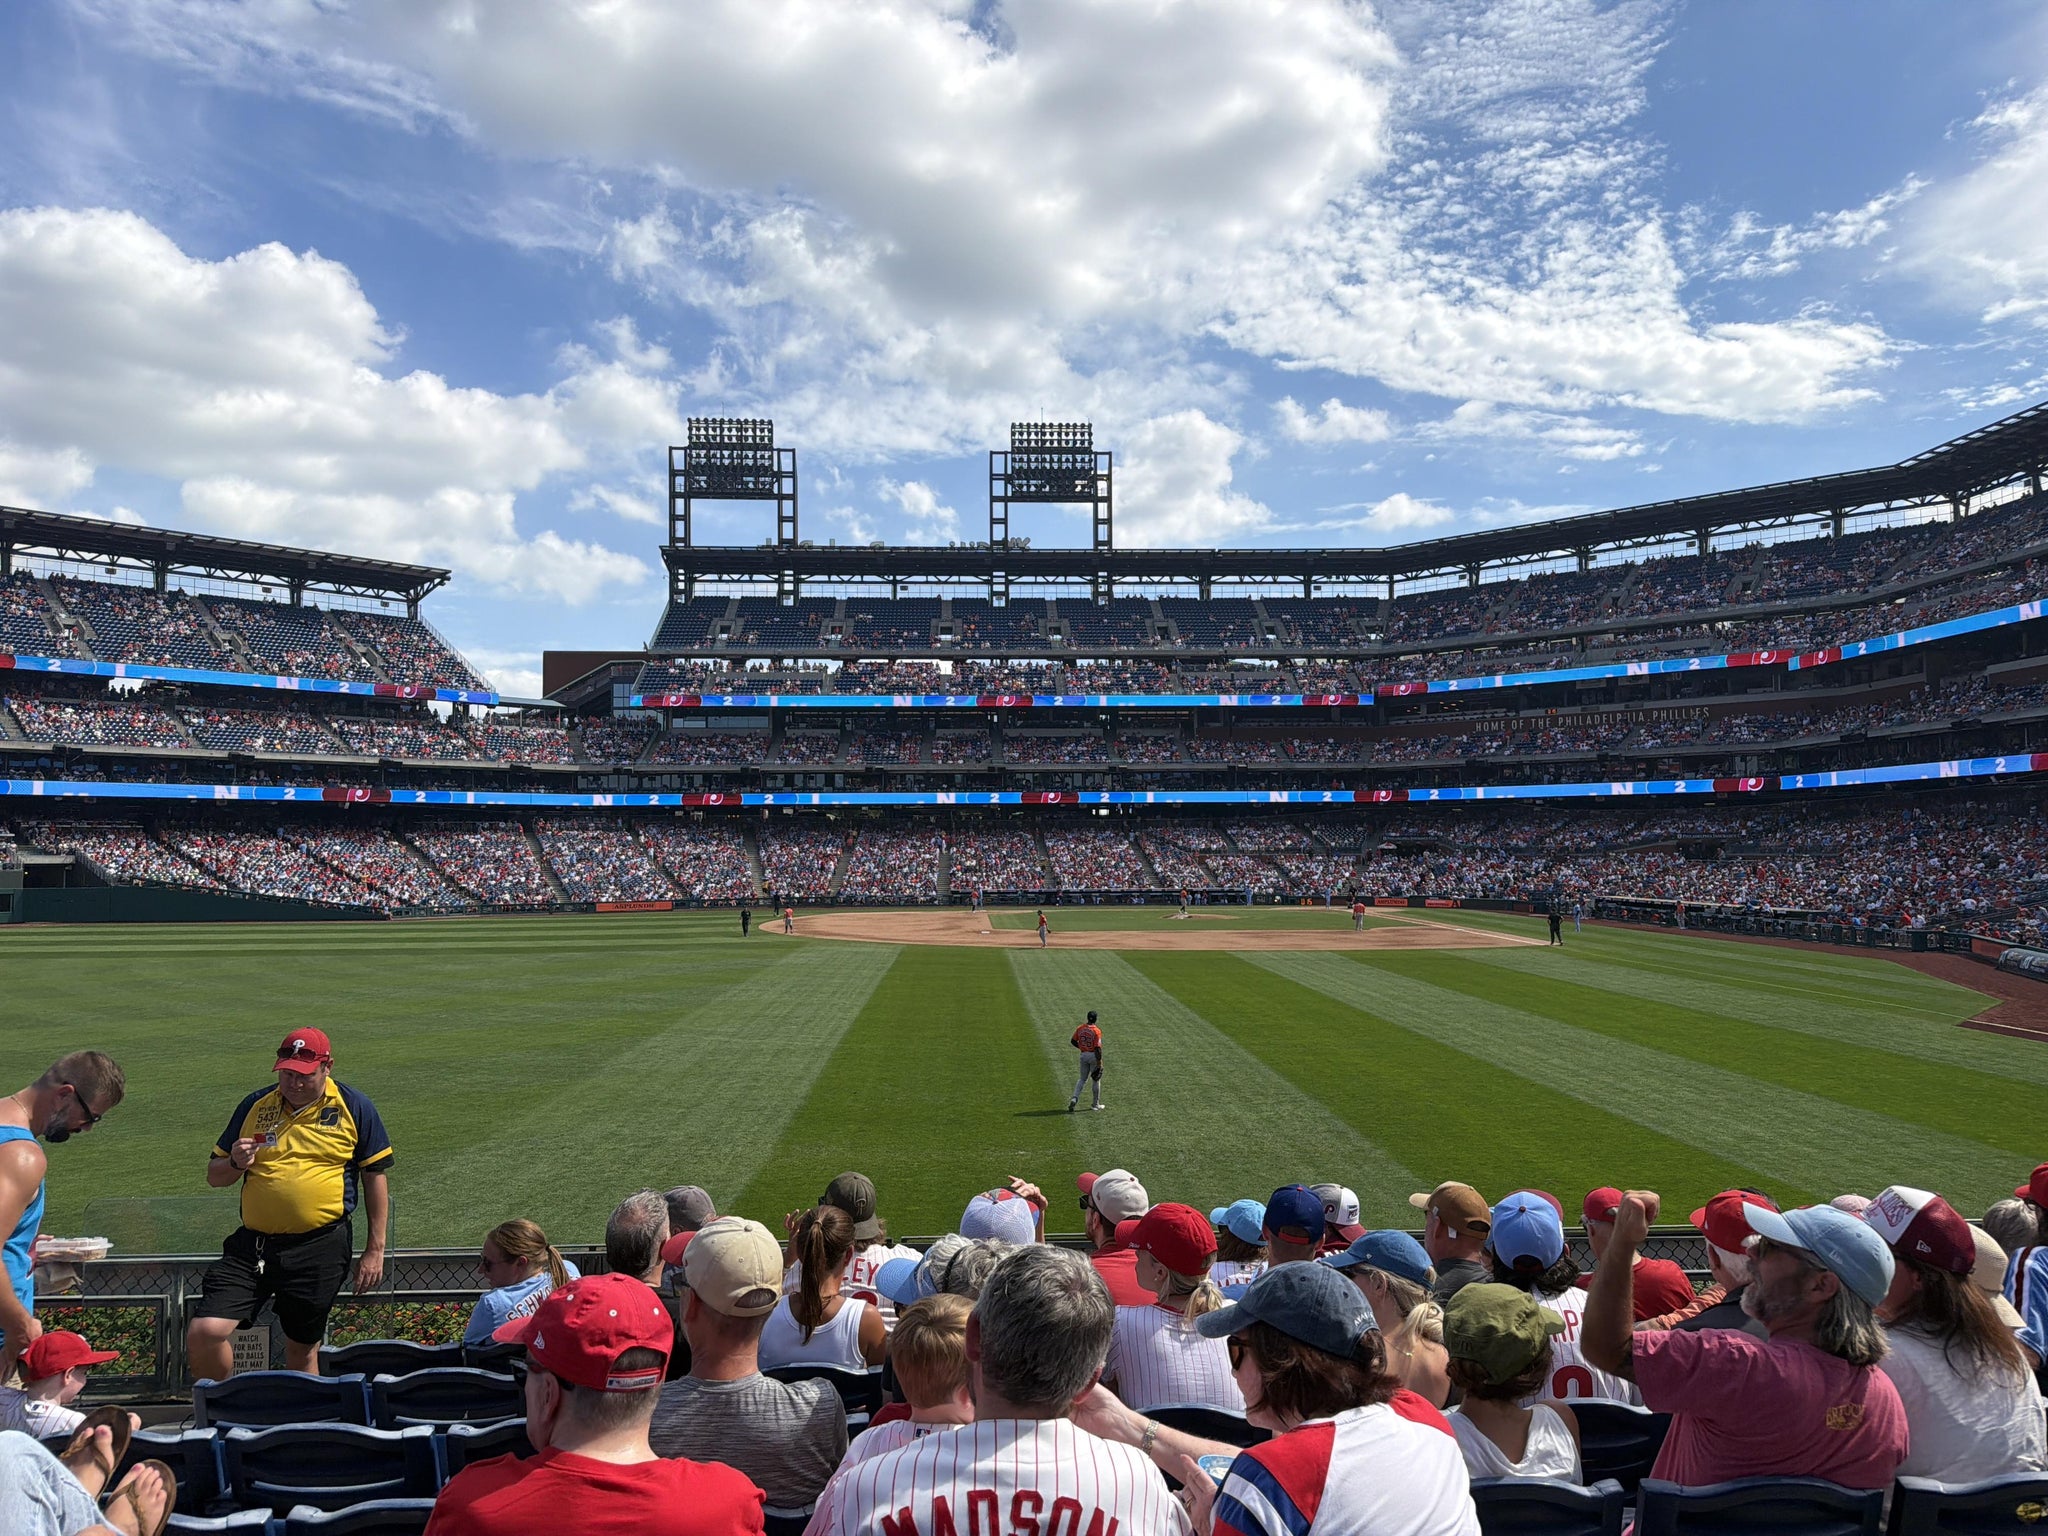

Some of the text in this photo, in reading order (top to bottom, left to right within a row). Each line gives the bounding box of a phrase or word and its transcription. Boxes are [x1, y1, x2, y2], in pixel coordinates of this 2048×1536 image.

[1858, 642, 1867, 655] 2
[2019, 602, 2041, 619] N
[48, 659, 61, 672] 2
[276, 676, 299, 689] N
[338, 682, 350, 693] 2
[458, 692, 468, 702] 2
[1448, 681, 1458, 691] 2
[1626, 662, 1649, 675] N
[1689, 658, 1700, 670] 2
[723, 696, 734, 706] 2
[894, 695, 912, 707] N
[946, 696, 956, 706] 2
[1054, 696, 1064, 706] 2
[1219, 695, 1238, 706] N
[1272, 696, 1282, 706] 2
[1475, 720, 1505, 732] HOME
[1511, 719, 1525, 731] OF
[1531, 717, 1551, 729] THE
[1652, 706, 1710, 722] PHILLIES
[214, 785, 239, 799] N
[283, 787, 296, 800] 2
[415, 791, 427, 803] 2
[592, 795, 613, 806] N
[649, 794, 660, 805] 2
[764, 794, 774, 804] 2
[936, 793, 956, 804] N
[990, 793, 1000, 804] 2
[1100, 793, 1111, 803] 2
[1269, 791, 1289, 803] N
[1322, 792, 1333, 803] 2
[1430, 789, 1440, 800] 2
[1611, 782, 1633, 795] N
[1674, 780, 1687, 793] 2
[1796, 776, 1804, 787] 2
[1939, 761, 1959, 777] N
[1995, 758, 2006, 772] 2
[257, 1111, 279, 1123] 5437
[233, 1343, 263, 1351] FOR BATS
[245, 1352, 264, 1360] BALLS
[233, 1360, 263, 1369] THAT MAY
